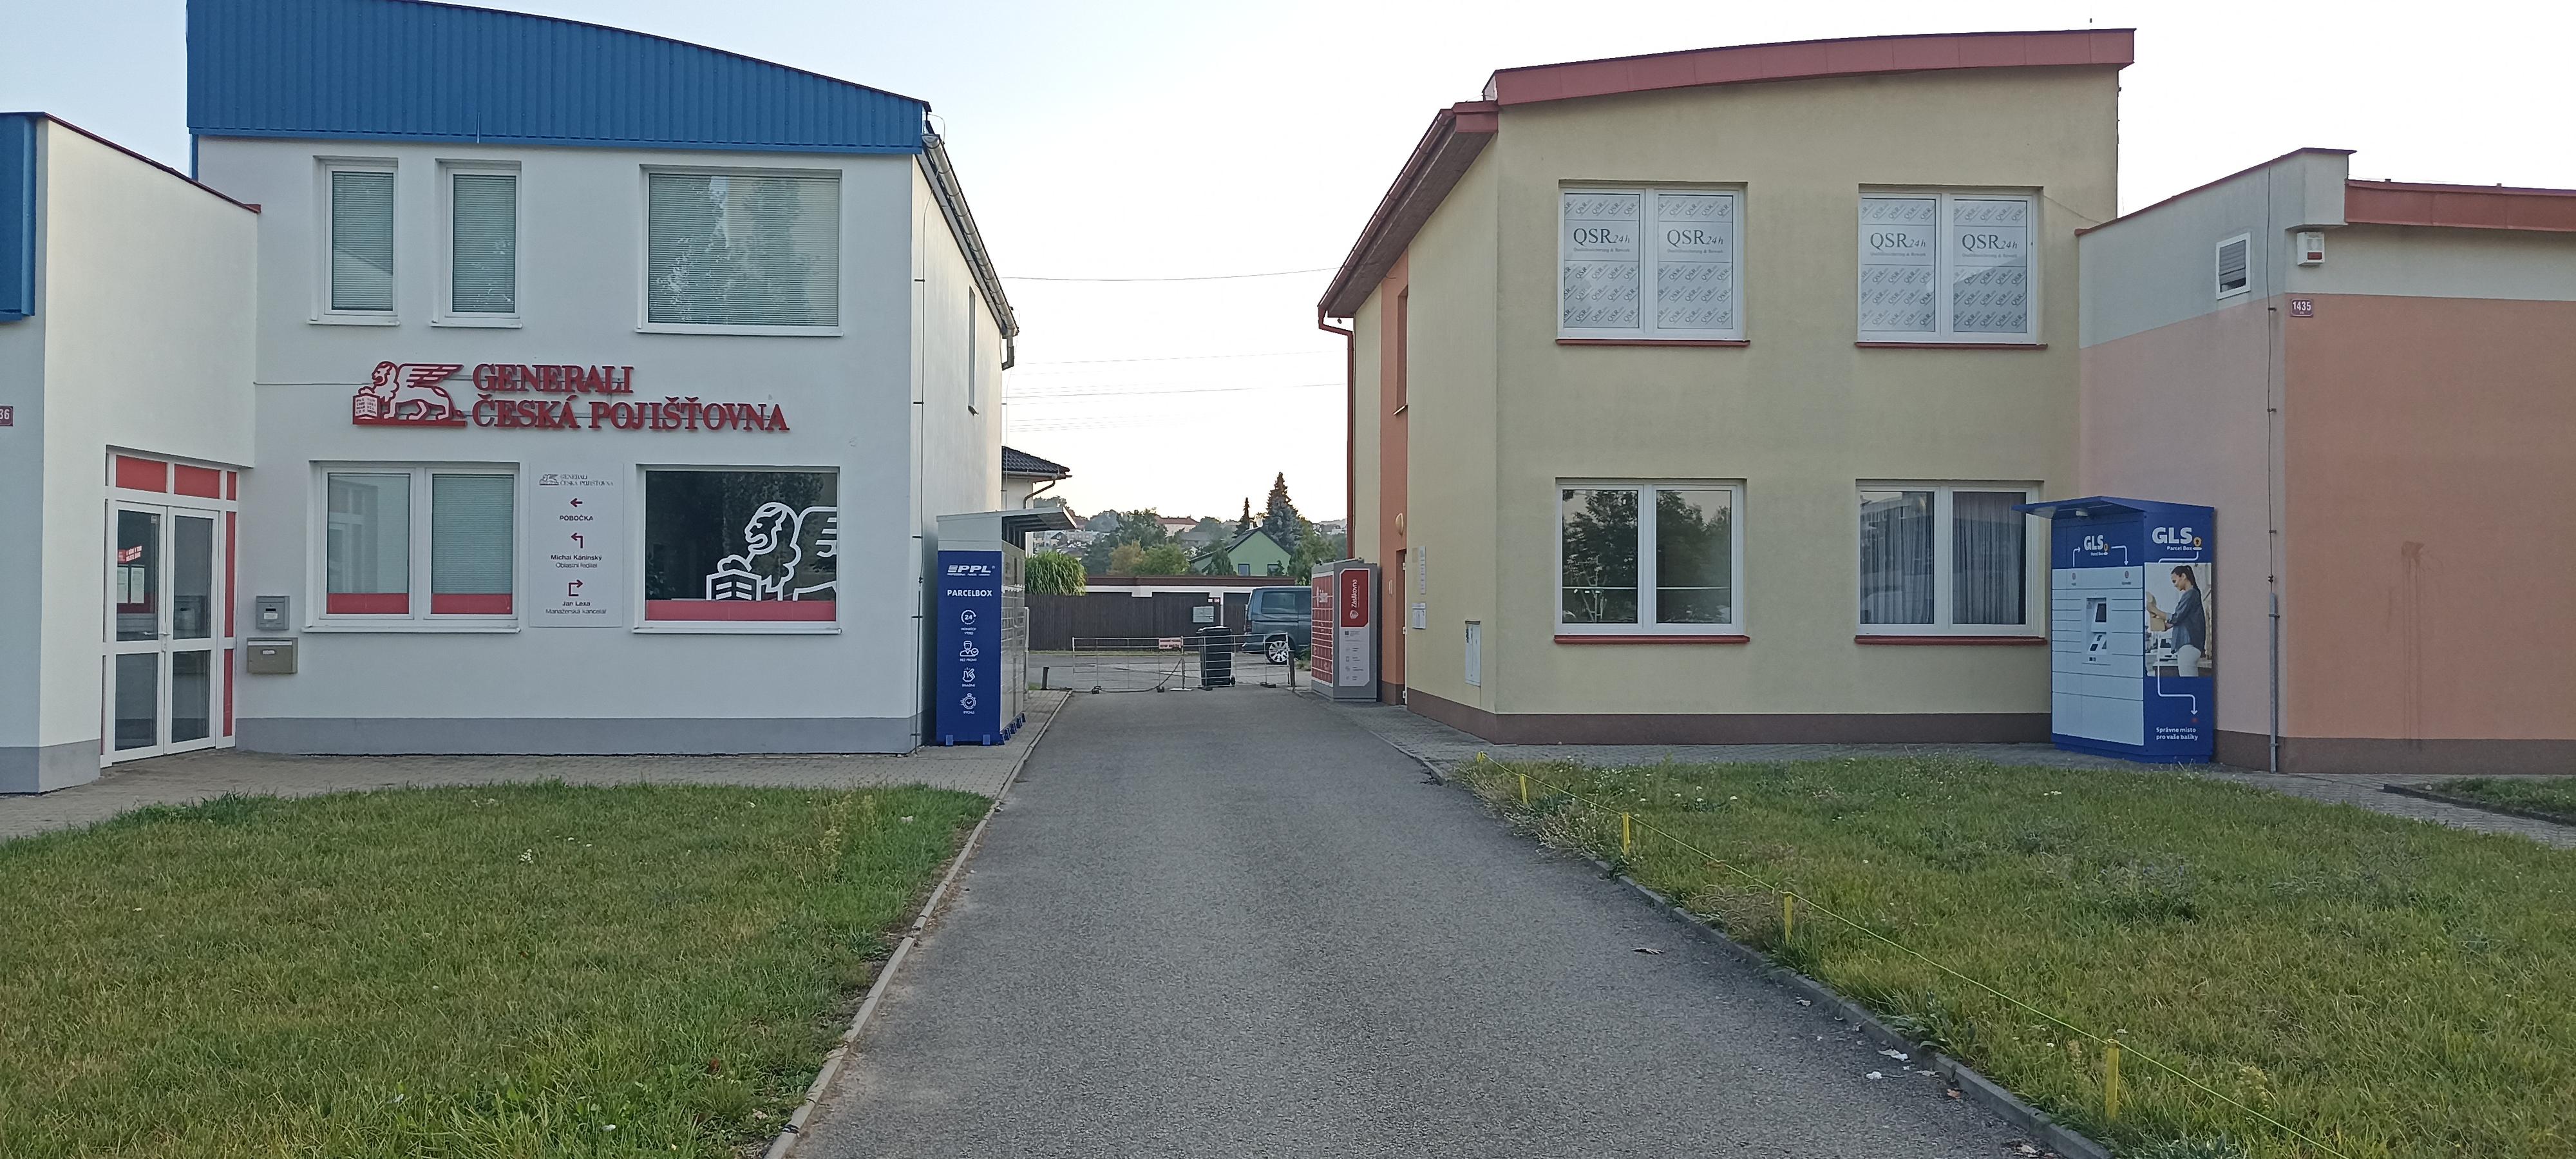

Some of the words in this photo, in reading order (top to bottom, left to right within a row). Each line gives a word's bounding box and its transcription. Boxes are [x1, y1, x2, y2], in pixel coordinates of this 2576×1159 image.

[2293, 302, 2311, 311] 1435
[473, 364, 634, 394] GENERALI
[472, 394, 581, 428] ČESKÁ
[588, 396, 790, 431] POJIŠŤOVNA
[2084, 535, 2103, 550] GLS
[2152, 527, 2192, 544] GLS
